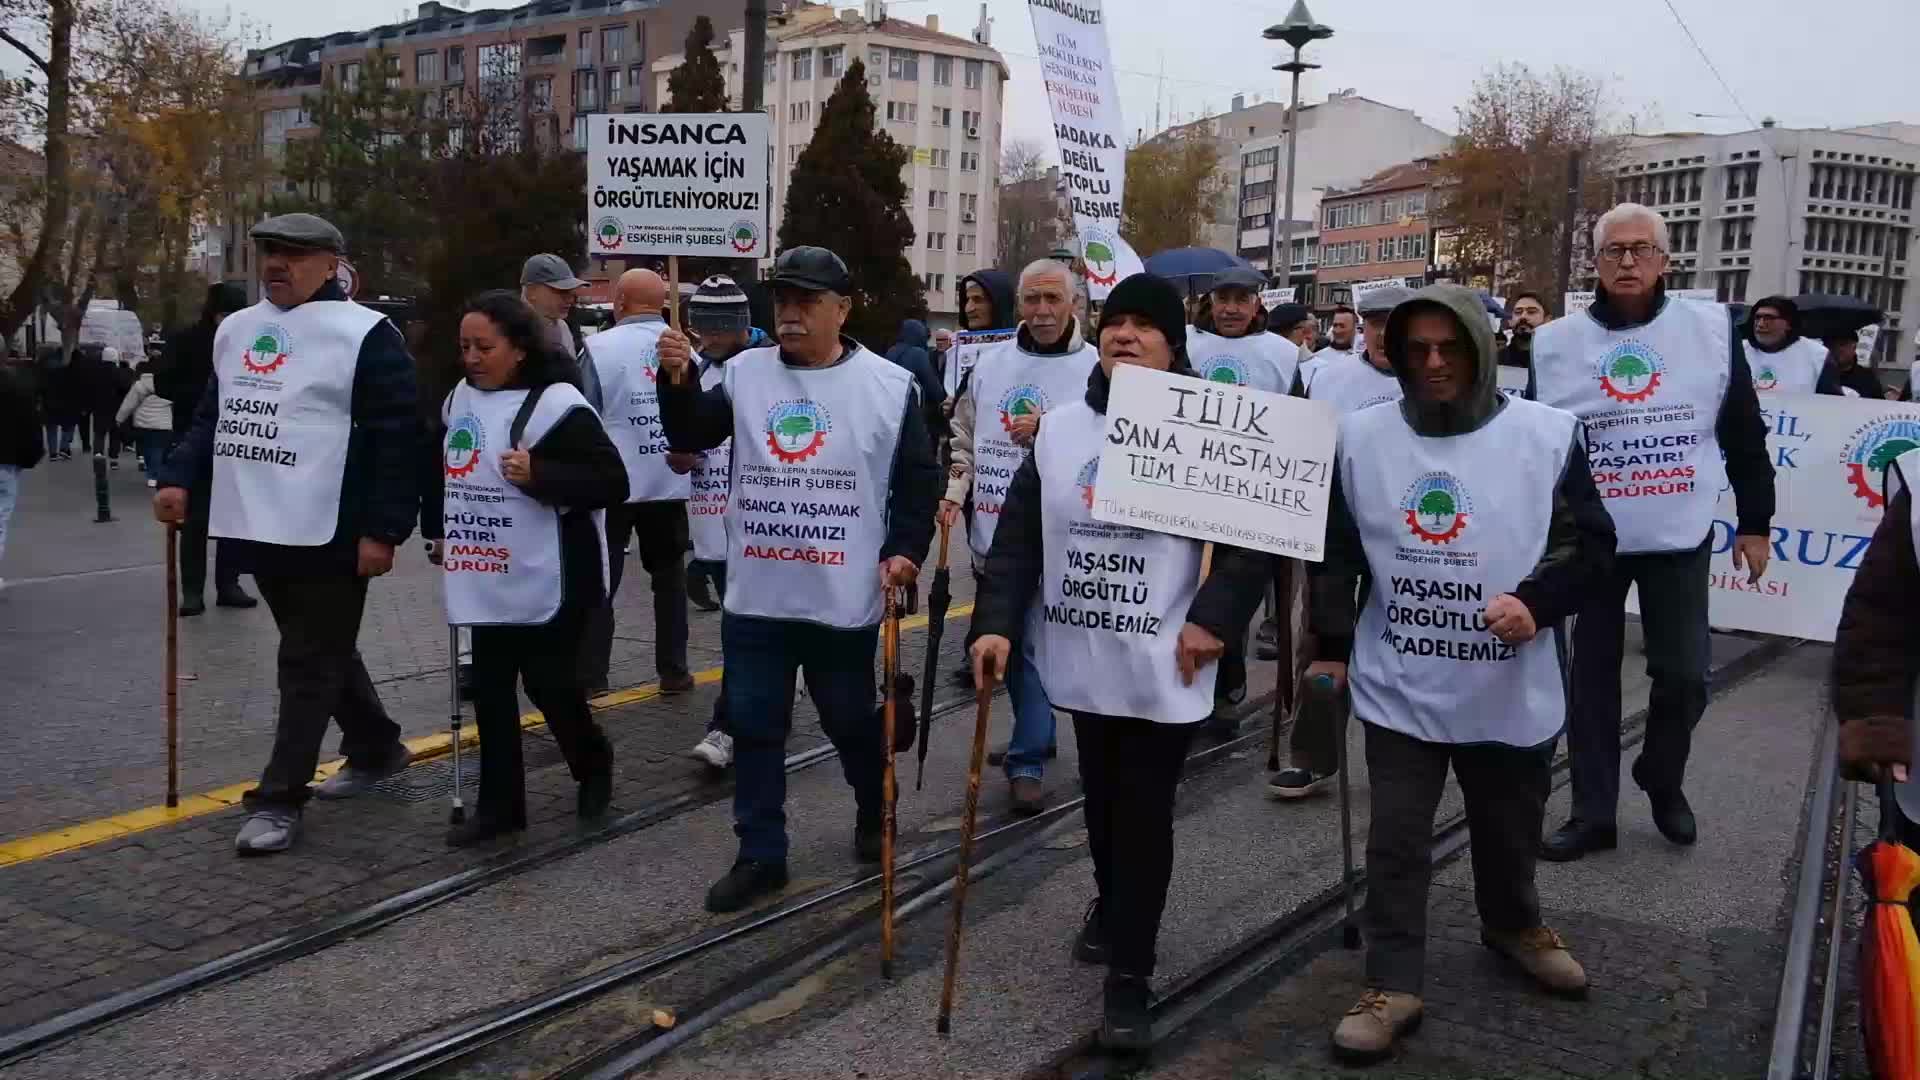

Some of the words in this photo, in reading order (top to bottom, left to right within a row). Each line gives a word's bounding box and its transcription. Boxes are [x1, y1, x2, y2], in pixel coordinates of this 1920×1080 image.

[1056, 32, 1077, 49] TÜM
[608, 118, 746, 144] İNSANCA
[1054, 122, 1117, 149] SADAKA
[607, 156, 697, 182] YAŞAMAK
[705, 151, 744, 183] İÇİN
[1063, 149, 1104, 172] DEĞİL
[1065, 172, 1110, 194] TOPLU
[594, 186, 759, 210] ÖRGÜTLENİYORUZ!
[1071, 197, 1120, 222] ZLEŞME
[627, 232, 682, 246] ESKİŞEHİR
[686, 234, 726, 247] ŞUBESİ
[1168, 387, 1269, 436] TÜİK
[1587, 416, 1640, 430] KİŞEHİR
[1644, 411, 1695, 424] ŞUBESİ
[214, 441, 297, 466] CADELEMİZ!
[639, 441, 669, 454] DEĞ
[1106, 417, 1183, 455] SANA
[1200, 437, 1327, 488] HASTAYIZ!
[1588, 441, 1614, 453] ÖK
[1622, 434, 1697, 450] HÜCRE
[743, 463, 757, 471] TÜM
[810, 468, 856, 477] SENDİKASI
[1589, 451, 1684, 469] YAŞATIR!
[740, 473, 800, 488] ESKİŞEHİR
[806, 478, 856, 491] ŞUBESİ
[975, 464, 1010, 479] NSANCA
[1592, 471, 1623, 483] ÖK
[1631, 465, 1696, 480] MAAŞ
[691, 480, 729, 491] YAŞAT
[1128, 453, 1175, 483] TÜM
[1184, 466, 1312, 512] EMEKLİLER
[1600, 481, 1695, 499] DÜRÜR!
[463, 491, 505, 503] ŞUBESİ
[445, 511, 513, 528] HÜCRE
[791, 502, 860, 518] YAŞAMAK
[447, 529, 496, 542] ATIR!
[744, 520, 846, 541] HAKKIMIZ!
[450, 545, 509, 560] MAAŞ
[743, 545, 845, 566] ALACAĞIZ!
[1067, 549, 1145, 574] YAŞASIN
[1396, 553, 1440, 565] ESKİŞEHİR
[1443, 557, 1478, 568] ŞUBESİ
[444, 558, 509, 574] ÜRÜR!
[1063, 575, 1148, 604] ÖRGÜTLÜ
[1391, 575, 1482, 602] YAŞASIN
[1707, 571, 1790, 597] DİKASI
[1044, 602, 1162, 636] MÜCADEEMİZ
[1387, 600, 1489, 632] ÖRGÜTLÜ
[1381, 624, 1517, 662] MCADELEMİZ!
